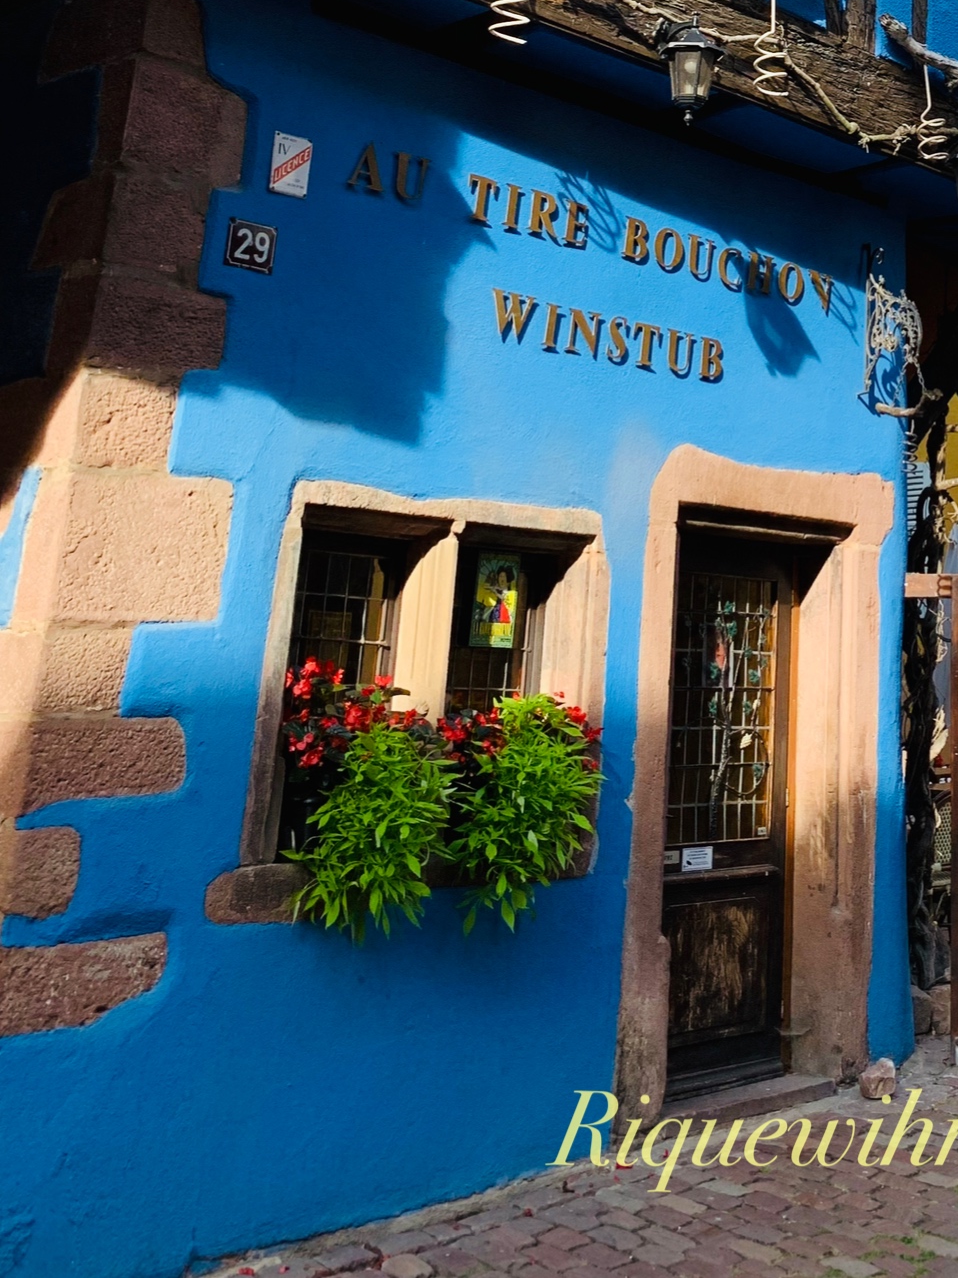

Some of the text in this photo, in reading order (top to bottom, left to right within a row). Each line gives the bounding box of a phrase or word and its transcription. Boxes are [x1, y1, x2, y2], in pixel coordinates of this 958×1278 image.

[273, 147, 311, 182] LICENCE
[278, 142, 291, 155] IV
[347, 140, 430, 201] AU
[468, 173, 589, 247] TIRE
[233, 228, 270, 263] 29
[492, 287, 724, 380] WINSTUB
